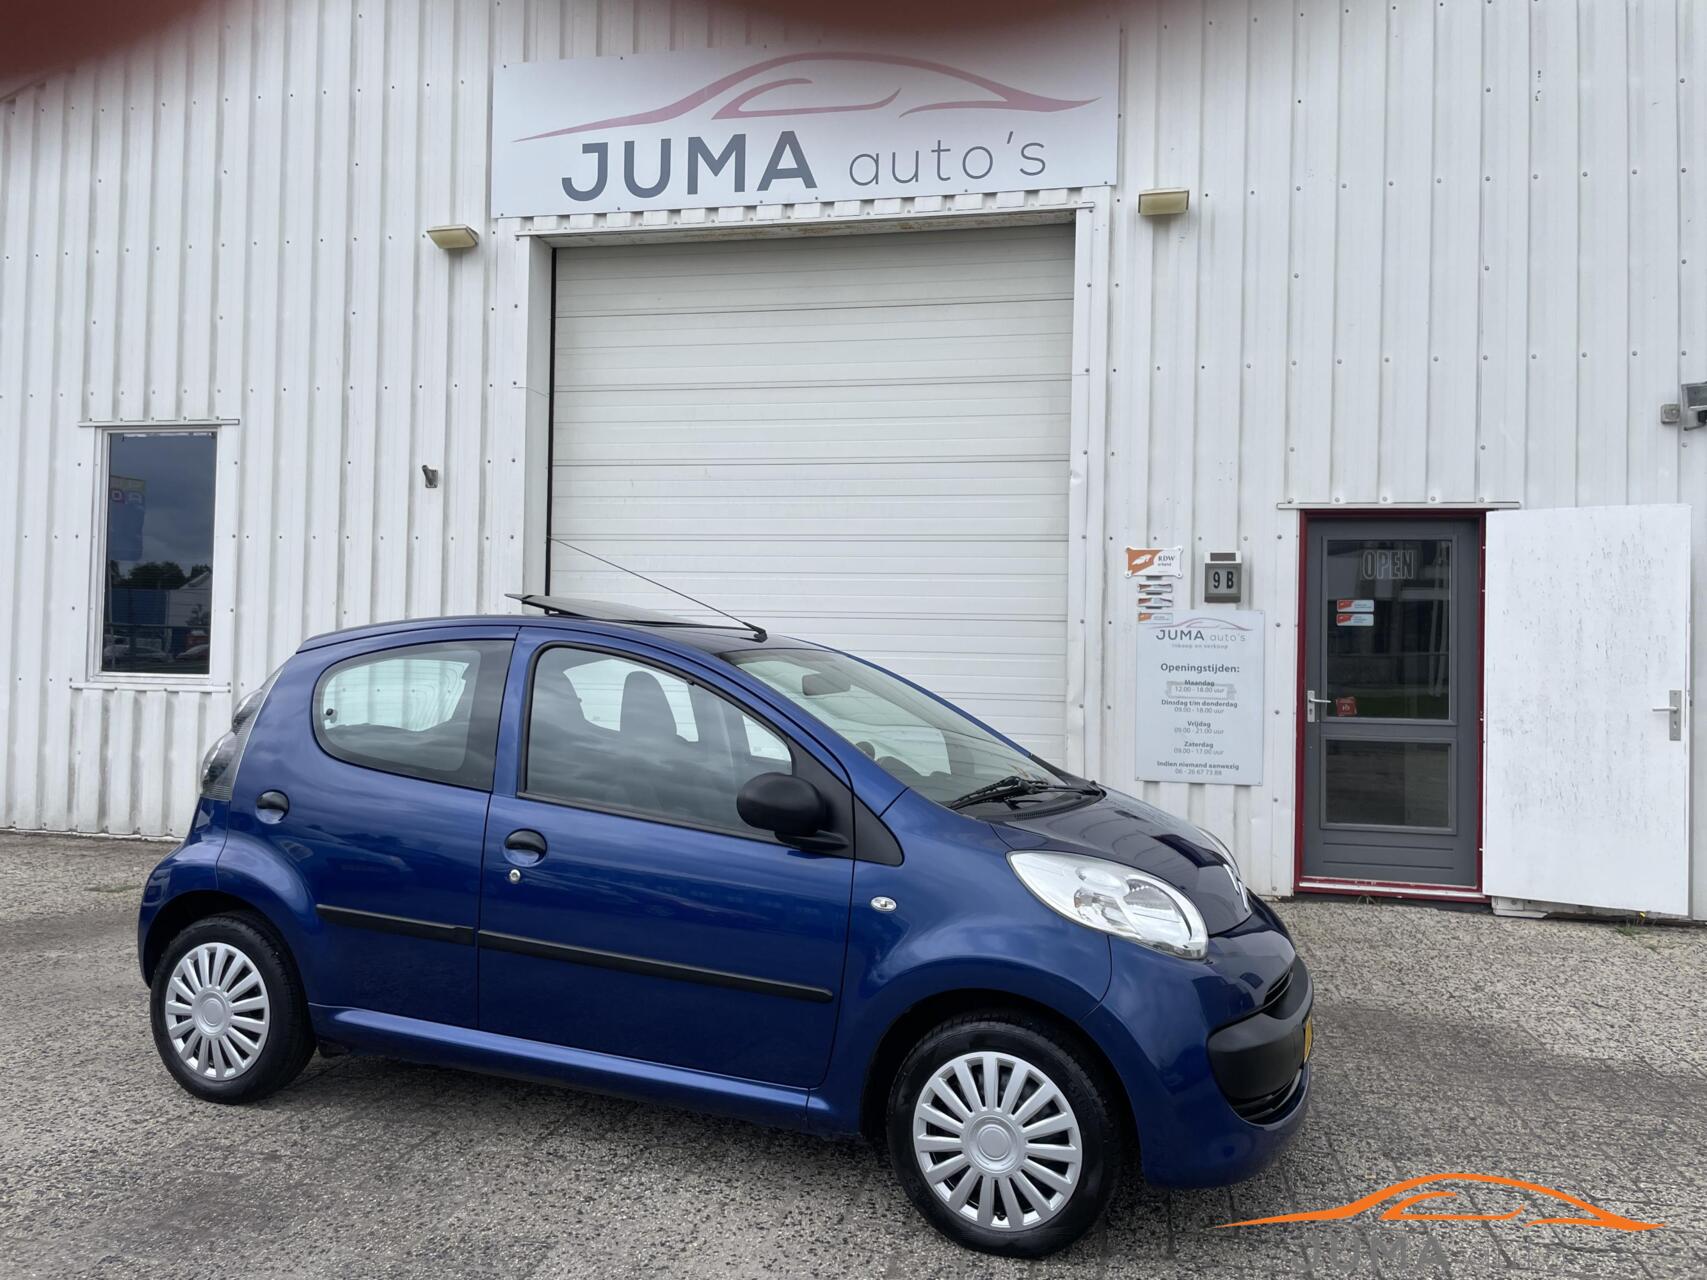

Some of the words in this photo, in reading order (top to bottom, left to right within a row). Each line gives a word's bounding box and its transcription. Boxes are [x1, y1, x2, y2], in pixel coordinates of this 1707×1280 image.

[561, 130, 818, 202] JUMA
[848, 131, 1047, 186] auto's
[1362, 549, 1415, 580] OPEN
[1212, 571, 1221, 589] 9
[1226, 571, 1234, 589] B
[1156, 629, 1205, 641] JUMA
[1209, 632, 1247, 642] auto's
[1160, 662, 1240, 674] Openingstijden:
[1184, 679, 1215, 687] Maandag
[1161, 699, 1188, 707] Dinsdag
[1201, 700, 1238, 708] donderdag
[1187, 720, 1211, 728] Vrijdag
[1184, 740, 1214, 749] Zaterdag
[1178, 761, 1208, 769] niemand
[1208, 763, 1240, 771] aanwezig
